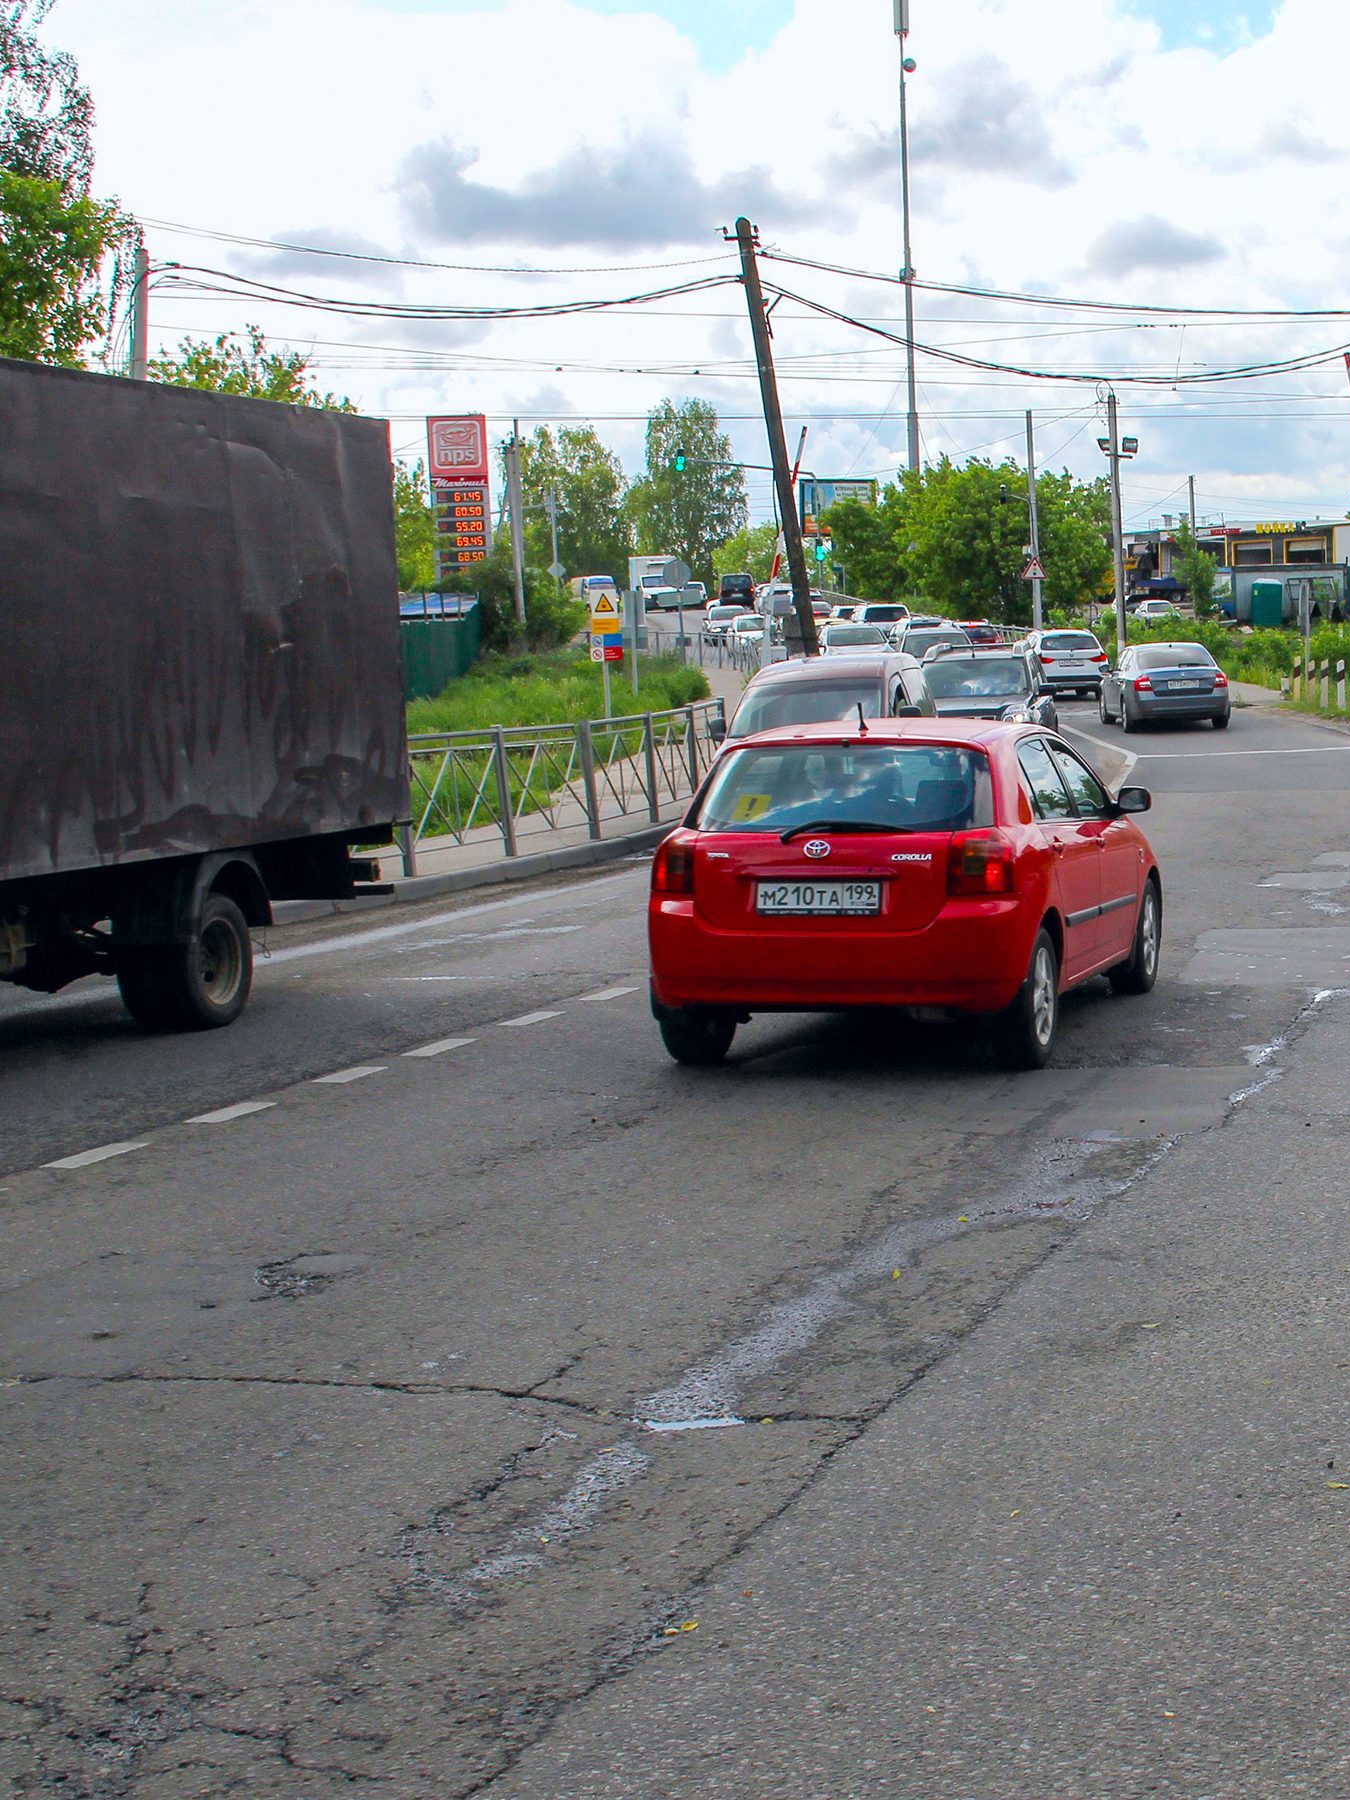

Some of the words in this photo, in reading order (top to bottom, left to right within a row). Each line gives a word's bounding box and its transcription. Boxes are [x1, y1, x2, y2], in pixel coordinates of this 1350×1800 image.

[440, 448, 475, 465] nps
[431, 477, 487, 488] Maximus
[454, 491, 481, 502] 61.45
[455, 506, 482, 517] 60.50
[456, 521, 483, 532] 55.20
[1255, 522, 1295, 534] МОЙКА
[456, 536, 484, 547] 69.45
[458, 551, 485, 562] 68.50
[891, 853, 932, 861] COROLLA
[763, 886, 840, 906] М210ТА
[844, 884, 874, 901] 199
